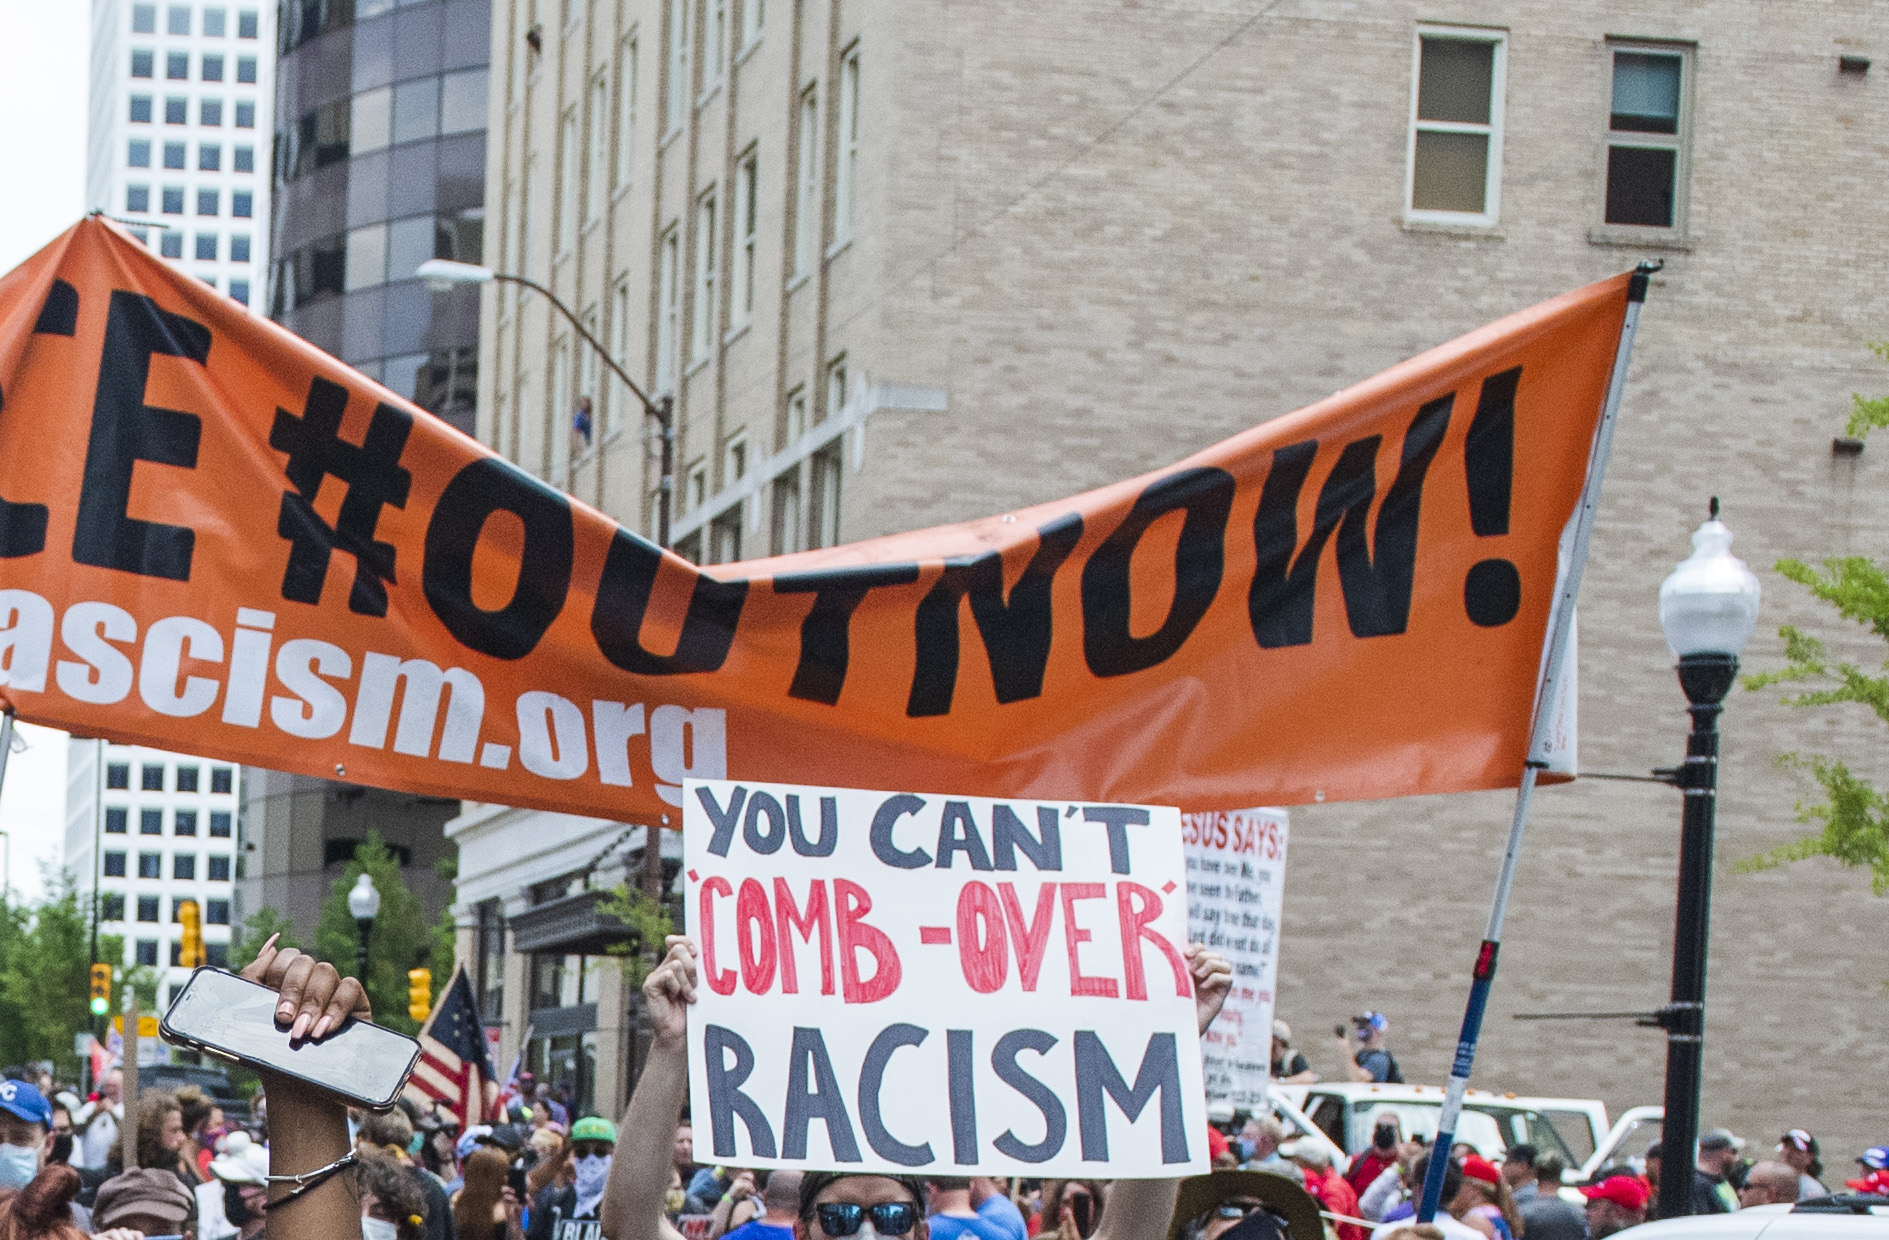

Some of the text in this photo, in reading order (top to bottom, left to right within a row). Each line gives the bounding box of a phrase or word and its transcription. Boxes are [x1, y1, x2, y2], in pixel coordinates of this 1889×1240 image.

[269, 364, 1524, 718] #OUTNOW!
[695, 785, 1150, 875] YOU CAN'T
[1183, 812, 1228, 849] ESUS
[703, 1022, 1191, 1166] RACISM
